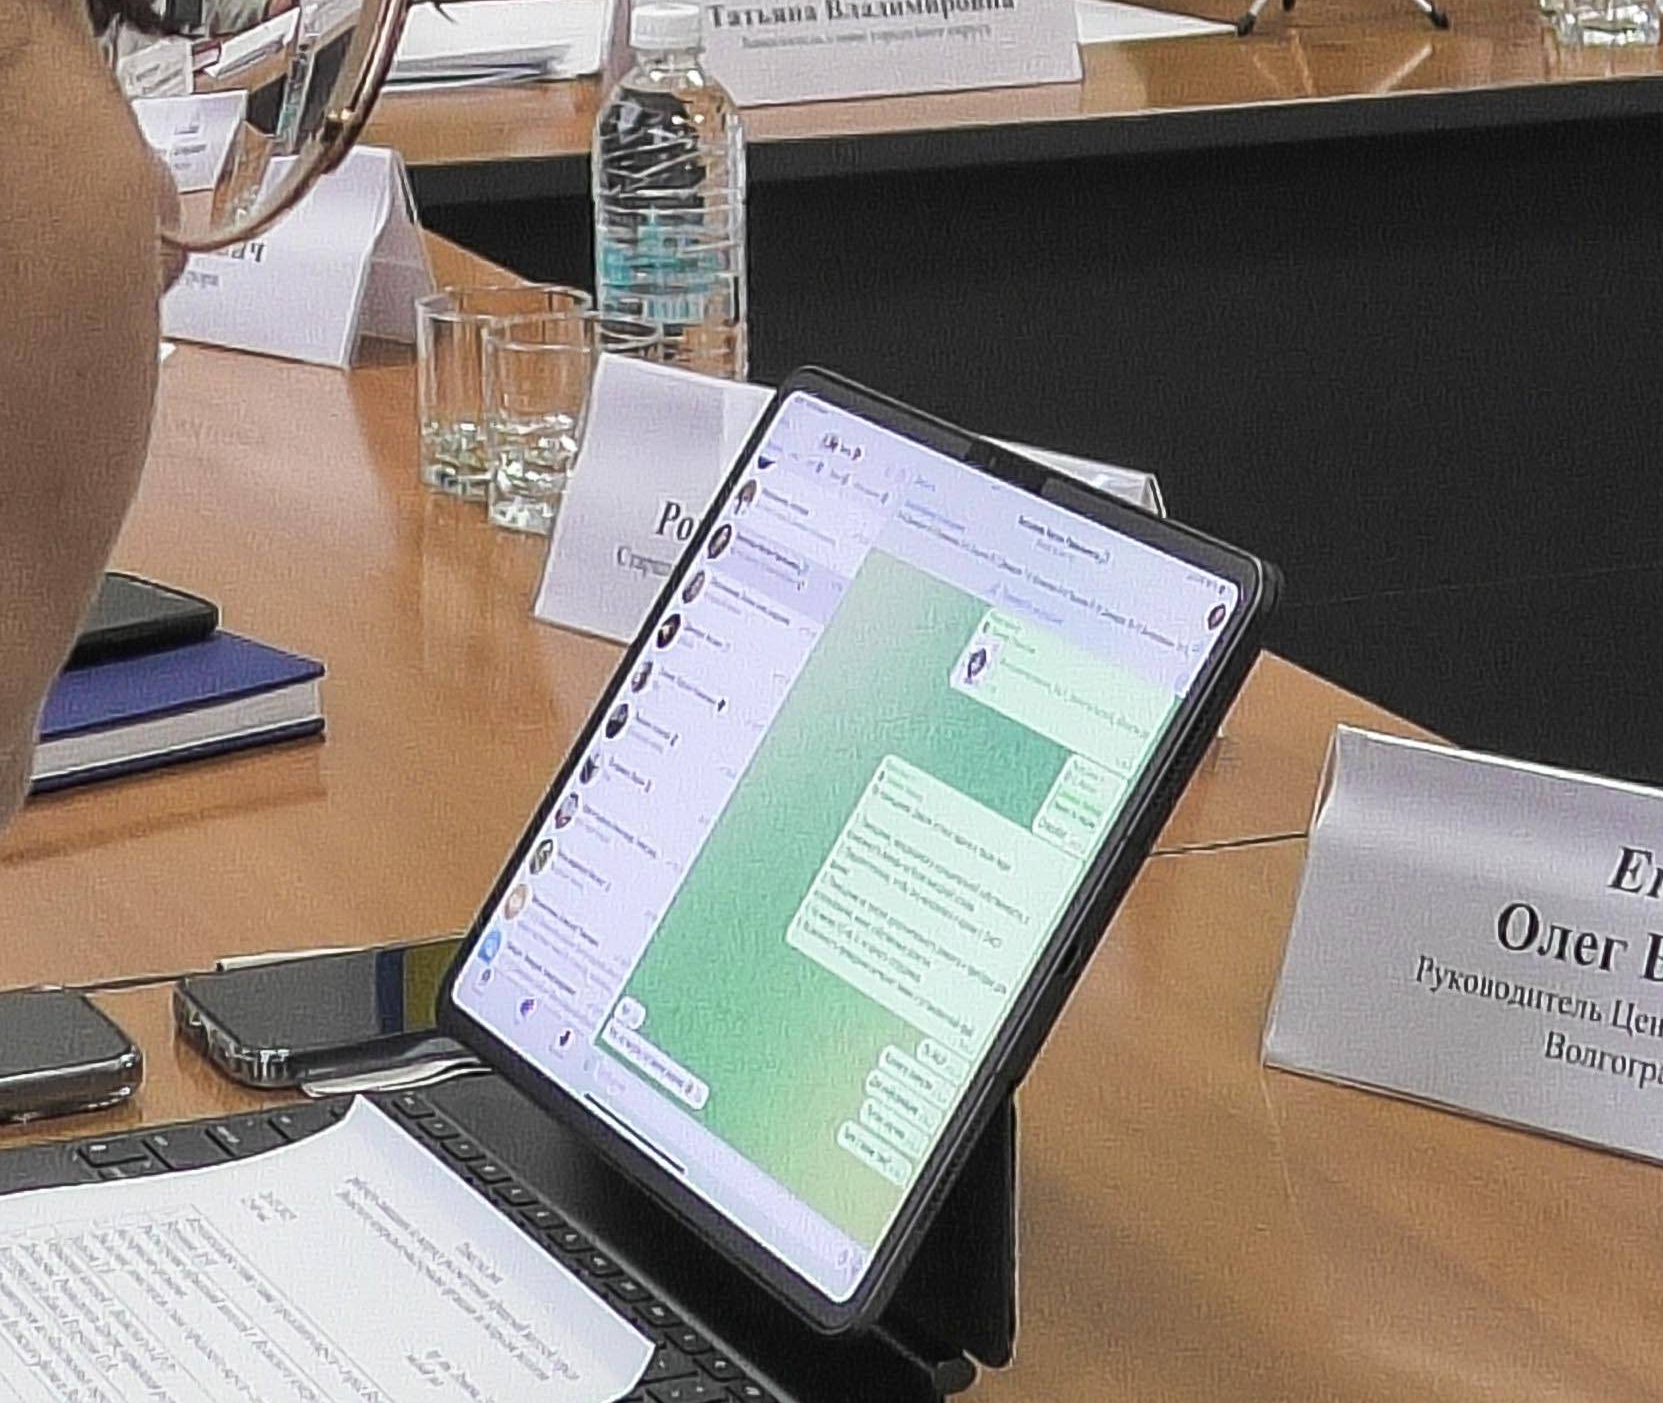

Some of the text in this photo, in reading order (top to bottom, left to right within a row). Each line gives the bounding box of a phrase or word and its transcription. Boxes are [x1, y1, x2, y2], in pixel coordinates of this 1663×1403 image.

[707, 3, 818, 29] Татьяна
[655, 499, 695, 541] Ро
[1497, 903, 1629, 972] Олег
[1416, 955, 1604, 1024] Руководитель
